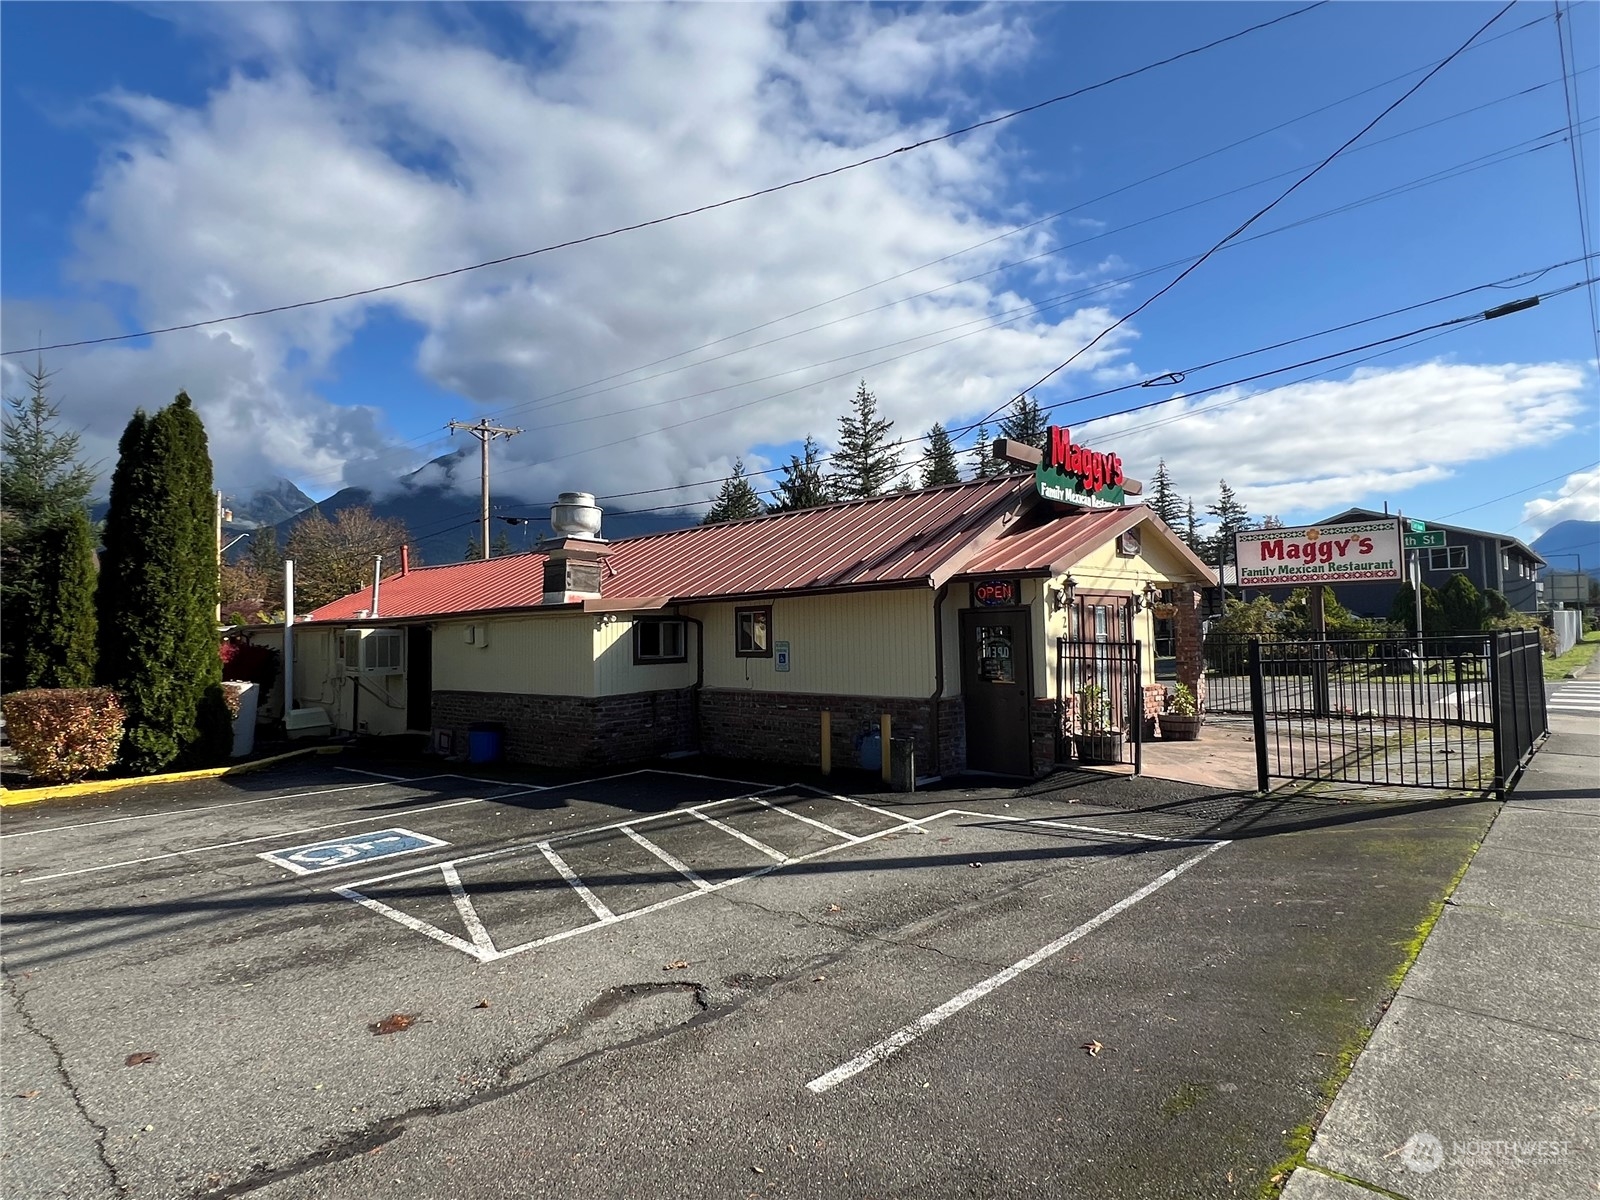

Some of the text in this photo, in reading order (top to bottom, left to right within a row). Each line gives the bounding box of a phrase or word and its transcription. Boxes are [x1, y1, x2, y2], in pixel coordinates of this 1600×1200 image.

[1049, 425, 1123, 492] Maggy's
[1041, 481, 1065, 499] Family
[1065, 488, 1092, 507] Mexican
[1261, 537, 1373, 565] Maggy's
[1422, 535, 1435, 545] St
[1241, 558, 1394, 578] Family Mexican Restaurant
[977, 584, 1012, 599] OPEN
